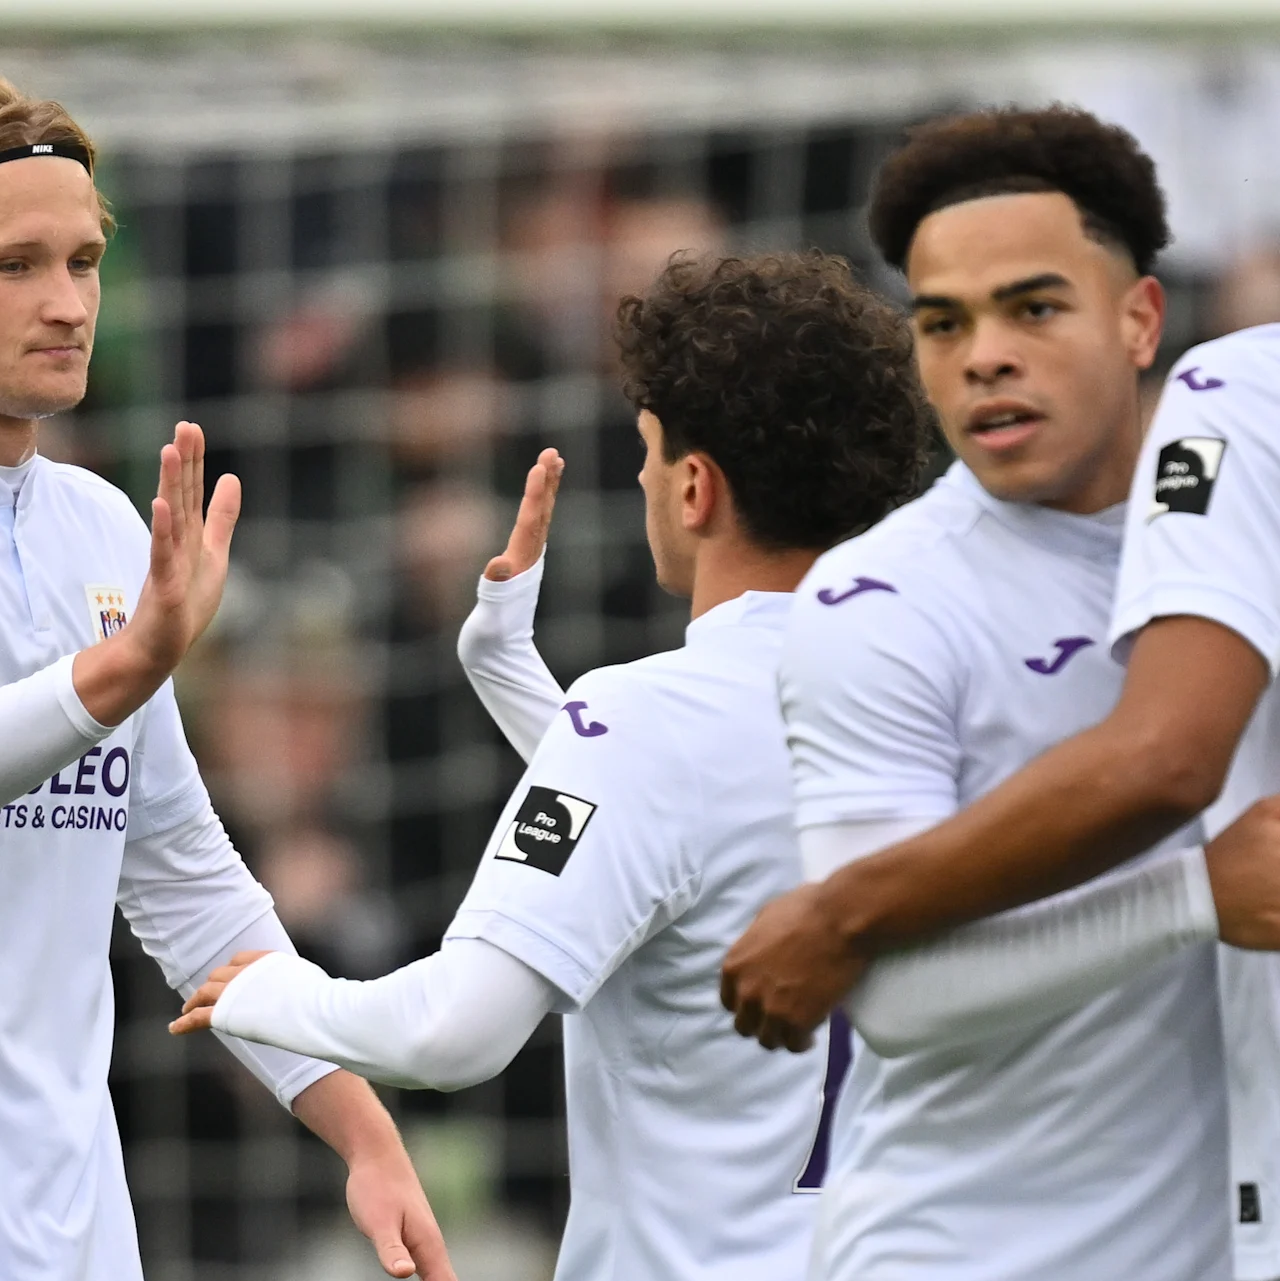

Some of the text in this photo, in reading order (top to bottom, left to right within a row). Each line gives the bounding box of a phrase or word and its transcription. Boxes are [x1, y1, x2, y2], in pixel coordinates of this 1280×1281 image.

[32, 144, 54, 154] NIKE
[28, 746, 130, 798] LEO
[32, 805, 46, 829] &
[51, 805, 128, 832] CASINO
[534, 811, 557, 827] Pro
[518, 822, 562, 844] League
